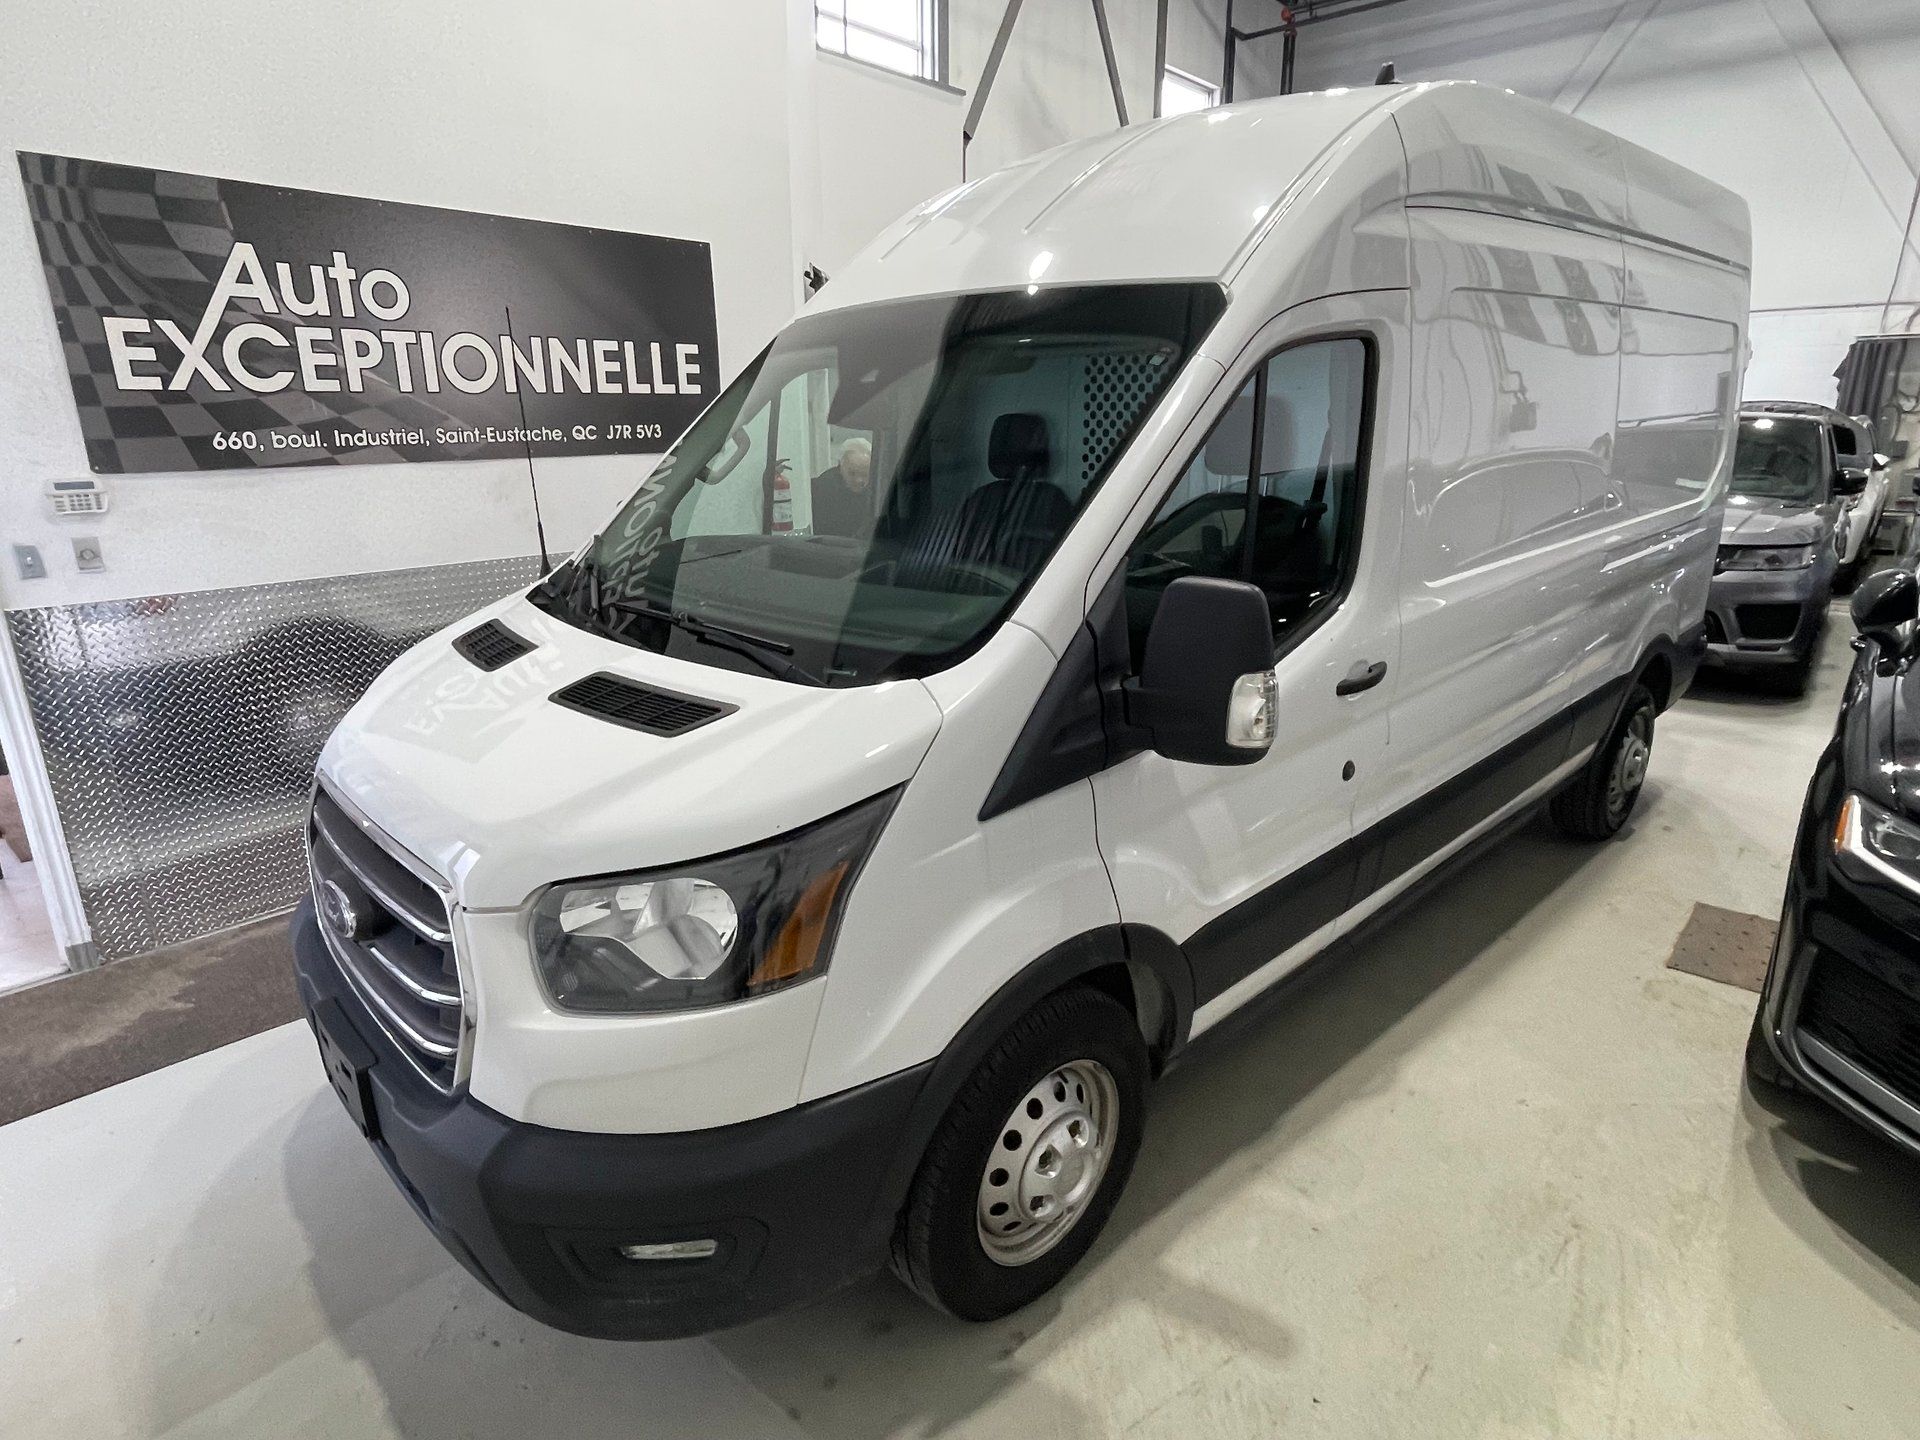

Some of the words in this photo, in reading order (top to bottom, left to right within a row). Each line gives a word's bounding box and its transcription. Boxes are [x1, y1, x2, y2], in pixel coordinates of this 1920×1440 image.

[204, 241, 411, 321] Auto
[102, 316, 702, 394] EXCEPTIONNELLE
[212, 430, 265, 452] 660,
[271, 430, 328, 449] boul.
[334, 428, 430, 447] Industriel,
[435, 426, 567, 444] Saint-Eustache,
[572, 425, 598, 440] QC
[606, 424, 632, 440] J7R
[636, 424, 663, 439] 5V3
